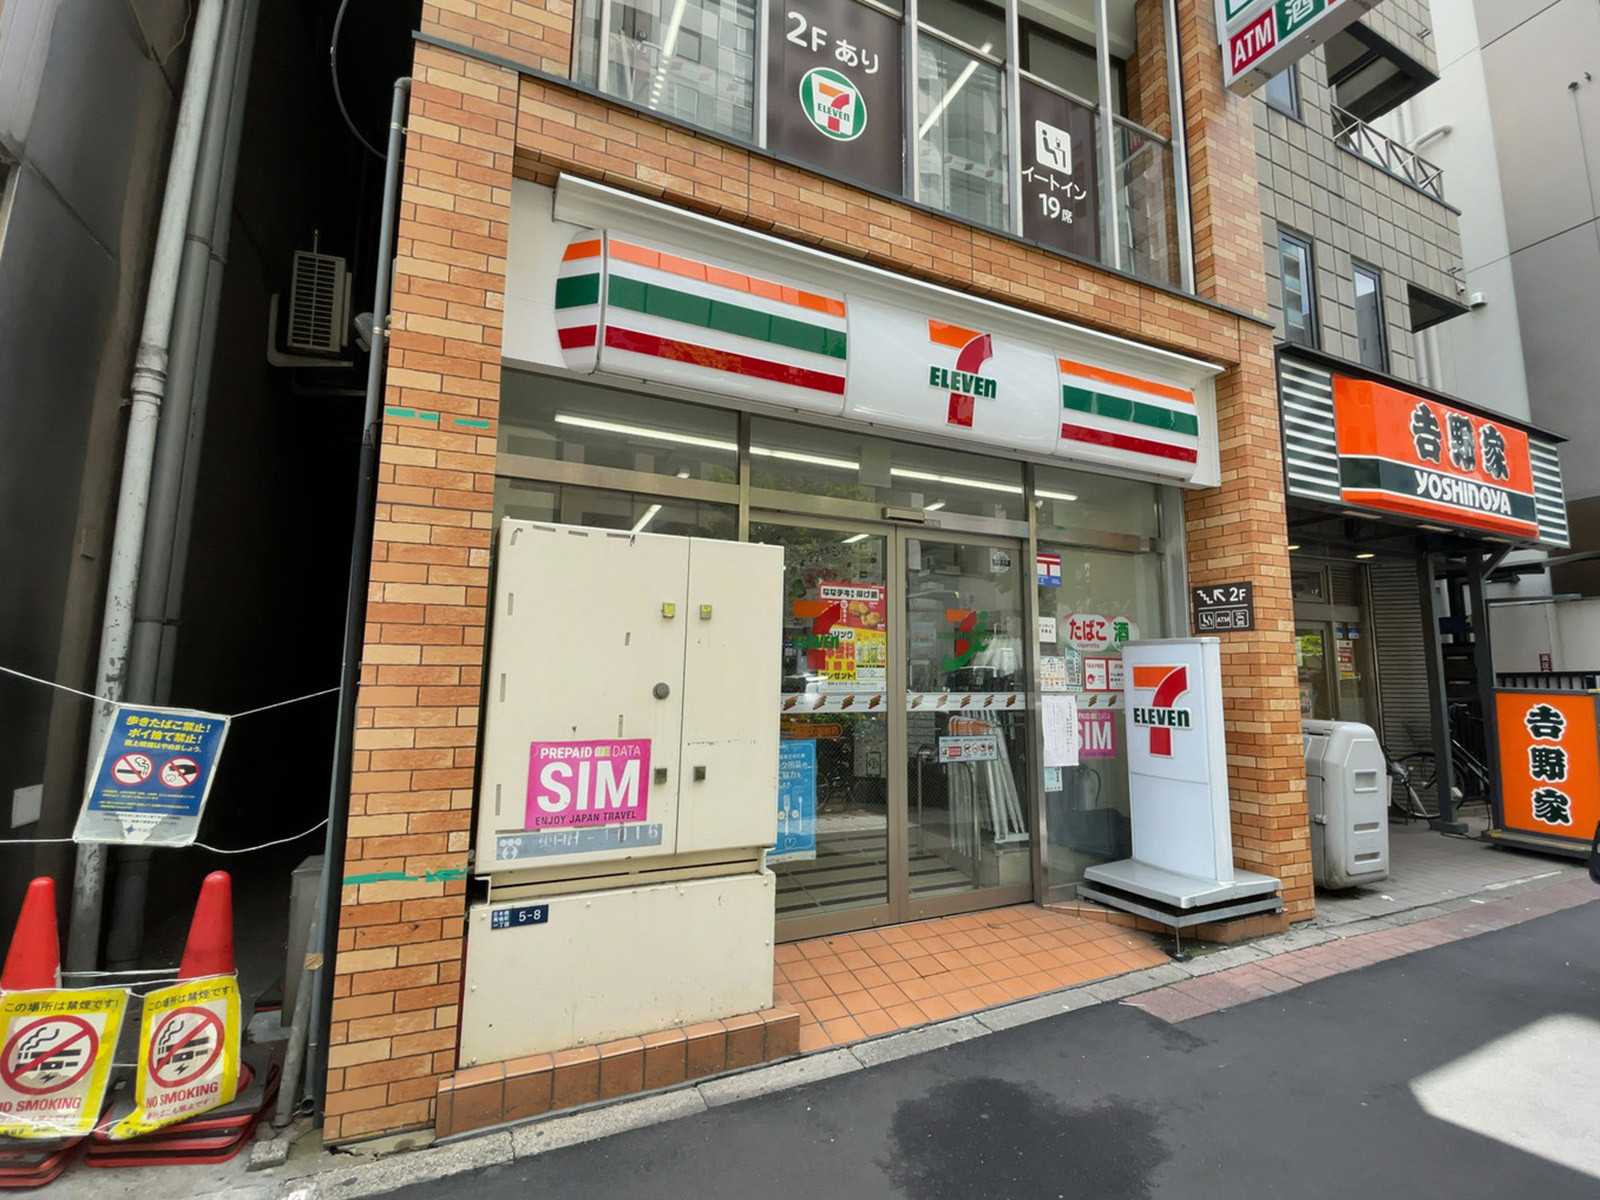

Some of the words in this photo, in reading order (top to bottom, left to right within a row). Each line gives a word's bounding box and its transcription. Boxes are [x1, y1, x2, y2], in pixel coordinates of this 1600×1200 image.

[787, 12, 828, 52] 2F
[835, 37, 879, 74] あり
[1234, 16, 1272, 68] ATM
[1021, 165, 1087, 201] イートイン
[1038, 193, 1073, 224] 19席
[1410, 402, 1510, 481] 吉野家
[1229, 587, 1247, 601] 2F
[1069, 619, 1107, 641] たばこ
[1113, 621, 1130, 642] 酒
[540, 746, 592, 759] PREPAID
[612, 745, 641, 757] DATA
[1524, 703, 1573, 826] 吉野家
[537, 759, 641, 813] SIM
[535, 815, 566, 825] ENJOY
[569, 812, 600, 824] JAPAN
[603, 810, 637, 821] TRAVEL
[518, 909, 541, 922] 5-8
[16, 1097, 82, 1112] SMOKING
[146, 1096, 158, 1109] NO
[159, 1081, 218, 1105] SMOKING
